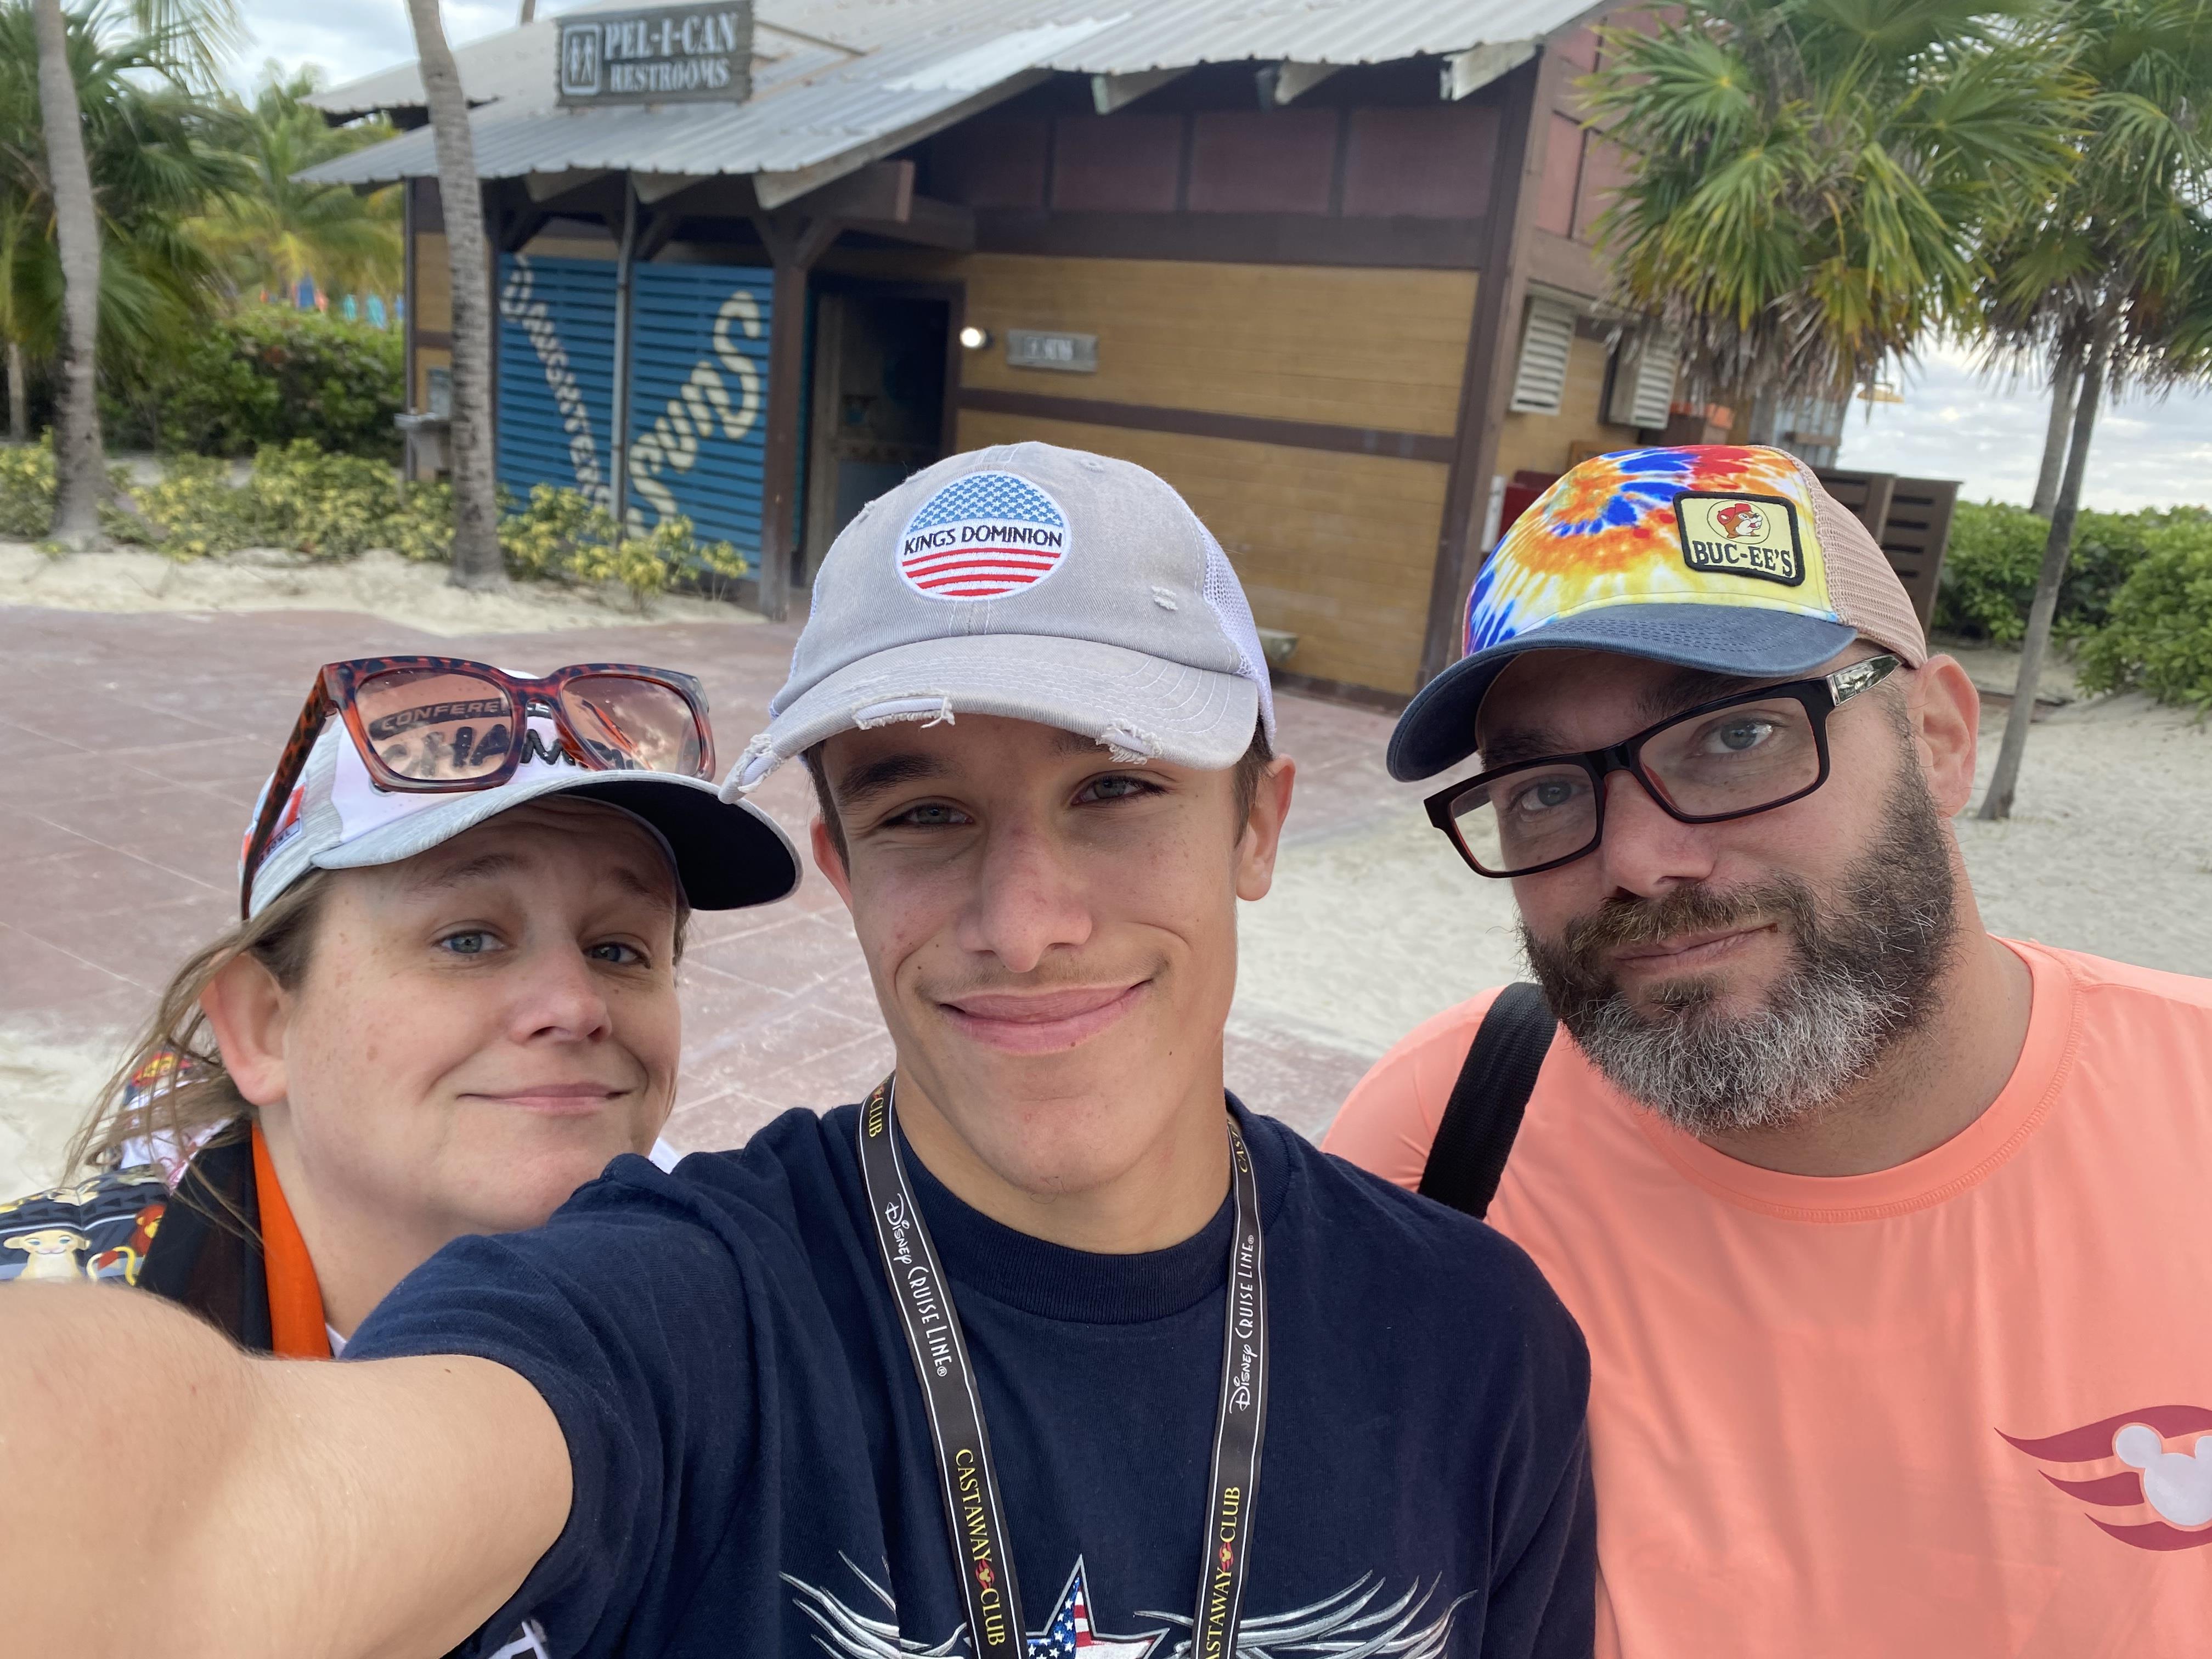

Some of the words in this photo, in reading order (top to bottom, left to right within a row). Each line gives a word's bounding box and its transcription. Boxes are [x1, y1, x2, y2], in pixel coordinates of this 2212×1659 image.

[604, 12, 738, 60] PEL-I-CAN
[610, 57, 731, 92] RESTROOMS
[904, 528, 956, 555] KINGS
[961, 526, 1062, 547] DOMINION
[1691, 540, 1793, 577] BUC-EE'S
[868, 1097, 884, 1138] CLUB
[907, 1266, 940, 1324] CRUISE
[1234, 1284, 1254, 1340] CRUISE
[1220, 1486, 1241, 1543] CLUB
[955, 1449, 992, 1563] CASTAWAY
[980, 1588, 1006, 1646] CLUB
